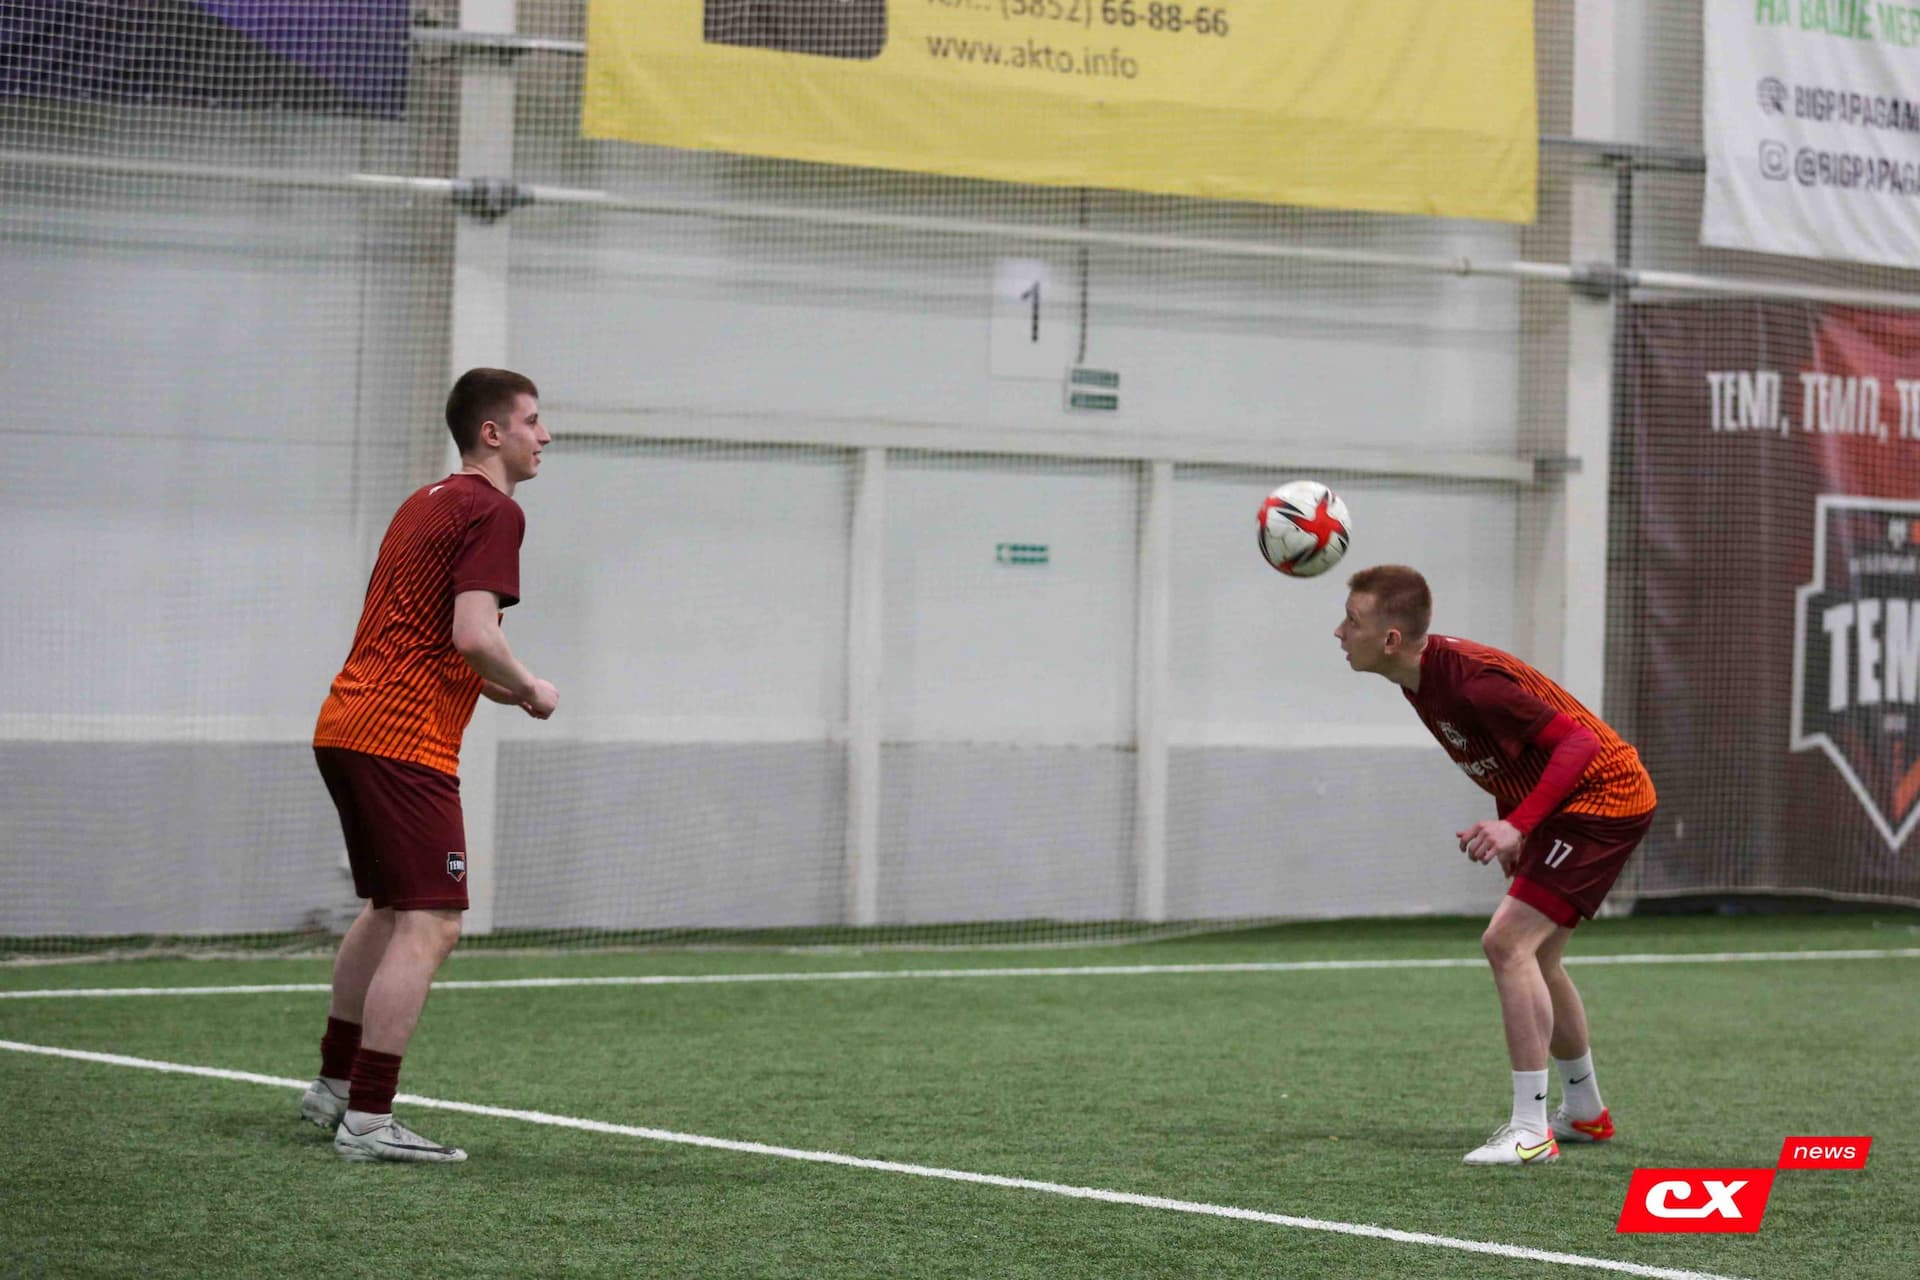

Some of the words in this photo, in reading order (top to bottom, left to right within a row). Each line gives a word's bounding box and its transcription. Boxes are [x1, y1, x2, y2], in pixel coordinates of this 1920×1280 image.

[1101, 1, 1230, 37] 66-88-66
[926, 35, 1139, 79] www.akto.info
[1021, 281, 1040, 344] 1
[1706, 371, 1790, 438] ТЕМП,
[1544, 838, 1574, 869] 17
